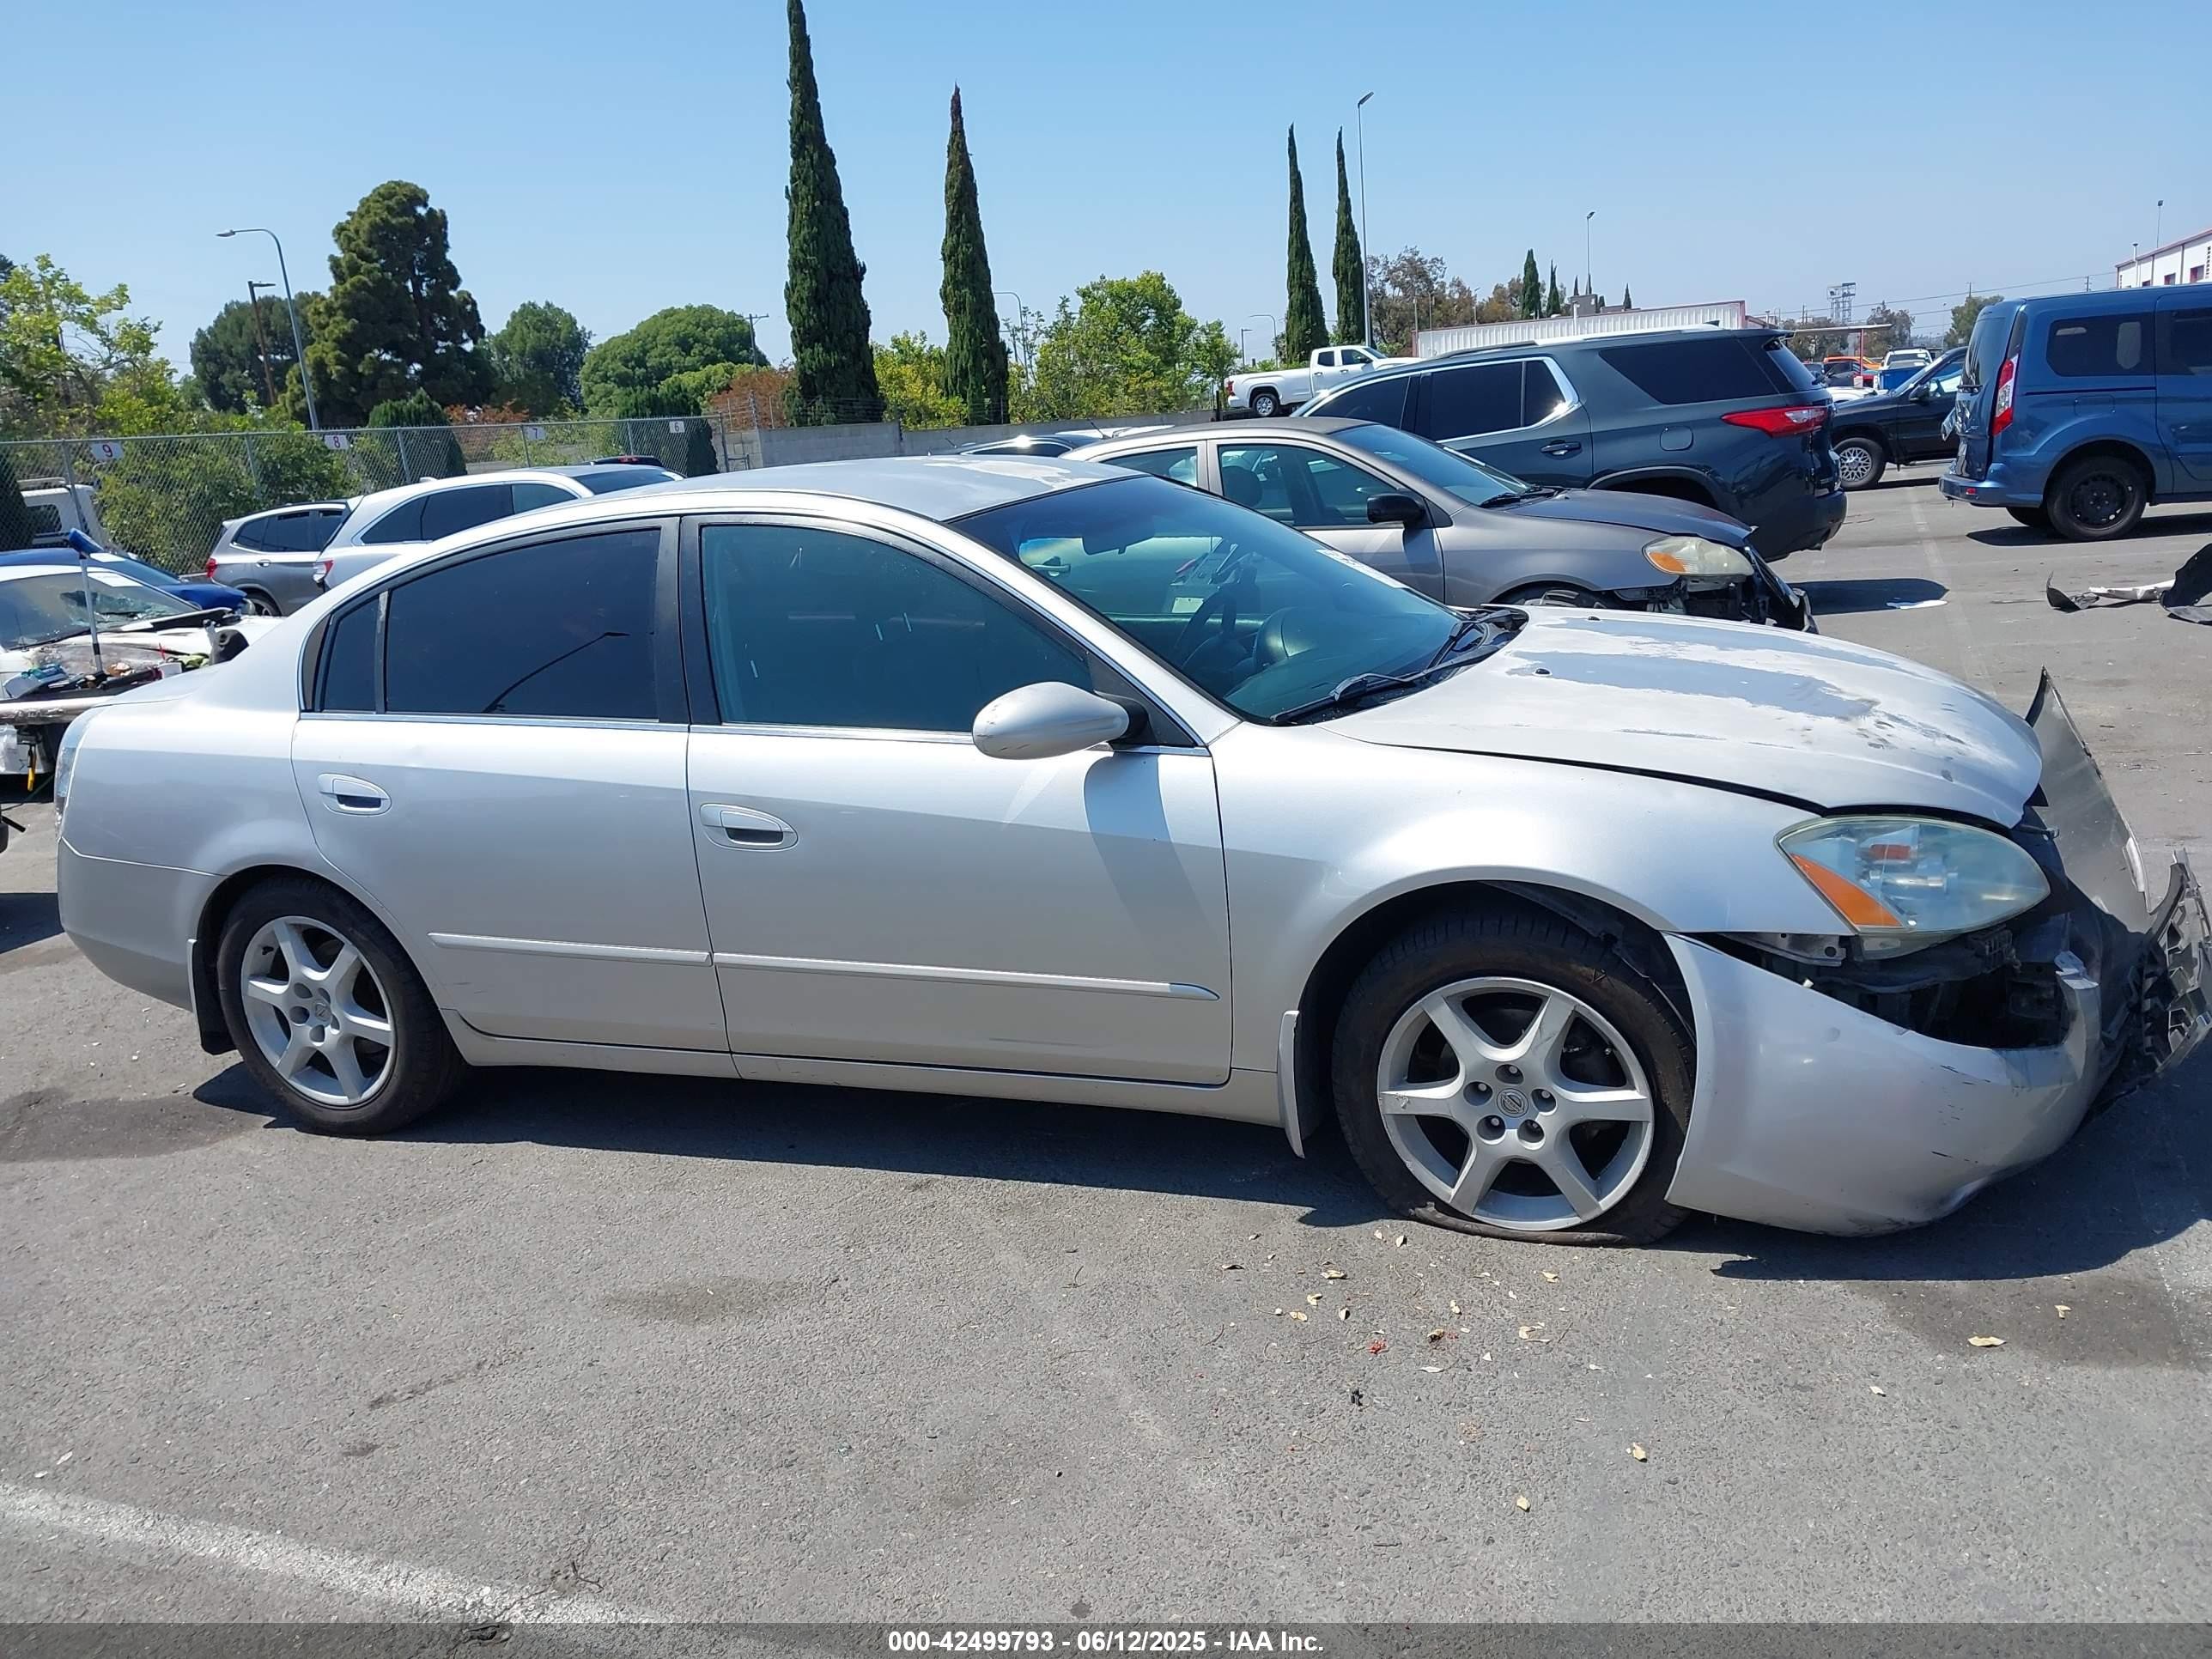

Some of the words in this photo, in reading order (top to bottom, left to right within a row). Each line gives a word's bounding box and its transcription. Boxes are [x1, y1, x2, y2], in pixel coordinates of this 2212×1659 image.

[674, 422, 680, 432] 6
[532, 428, 538, 439] 7
[333, 435, 341, 448] 8
[102, 444, 113, 458] 9
